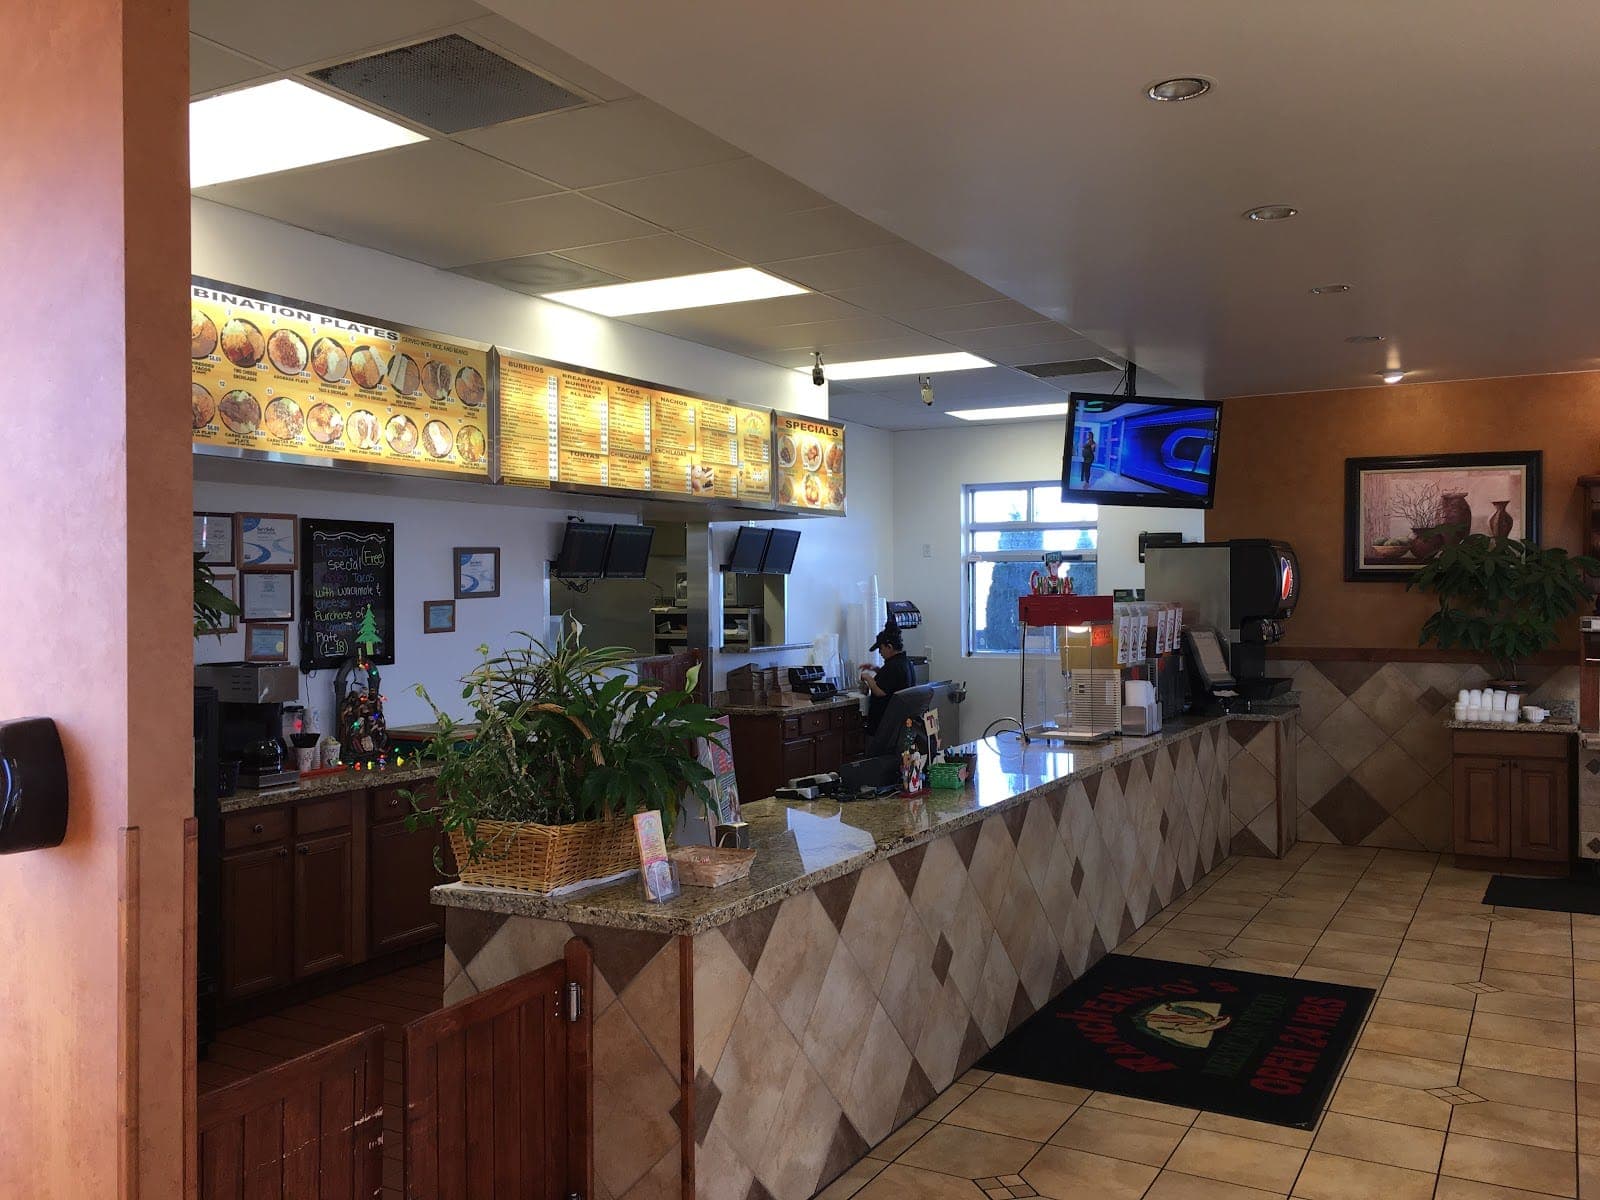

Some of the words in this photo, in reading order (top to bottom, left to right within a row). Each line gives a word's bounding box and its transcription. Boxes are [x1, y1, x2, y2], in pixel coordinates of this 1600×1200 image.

[193, 287, 312, 322] BINATION
[320, 316, 399, 341] PLATES
[508, 361, 544, 374] BURRITOS
[562, 373, 604, 386] BREAKFAST
[565, 380, 602, 392] BURRITOS
[617, 386, 640, 395] TACOS
[660, 396, 688, 407] NACHOS
[785, 420, 839, 437] SPECIALS
[569, 450, 600, 460] TORTAS
[610, 451, 648, 462] CHIMICHANGAS
[655, 447, 687, 457] ENCHILADAS
[316, 543, 359, 560] Tuesday
[362, 545, 386, 569] (Free)
[352, 572, 375, 584] Tacos
[315, 585, 335, 599] with
[355, 607, 366, 619] of
[316, 631, 337, 643] Plate
[1290, 996, 1348, 1028] HRS
[1279, 1024, 1332, 1049] 24
[1249, 1046, 1321, 1095] OPEN
